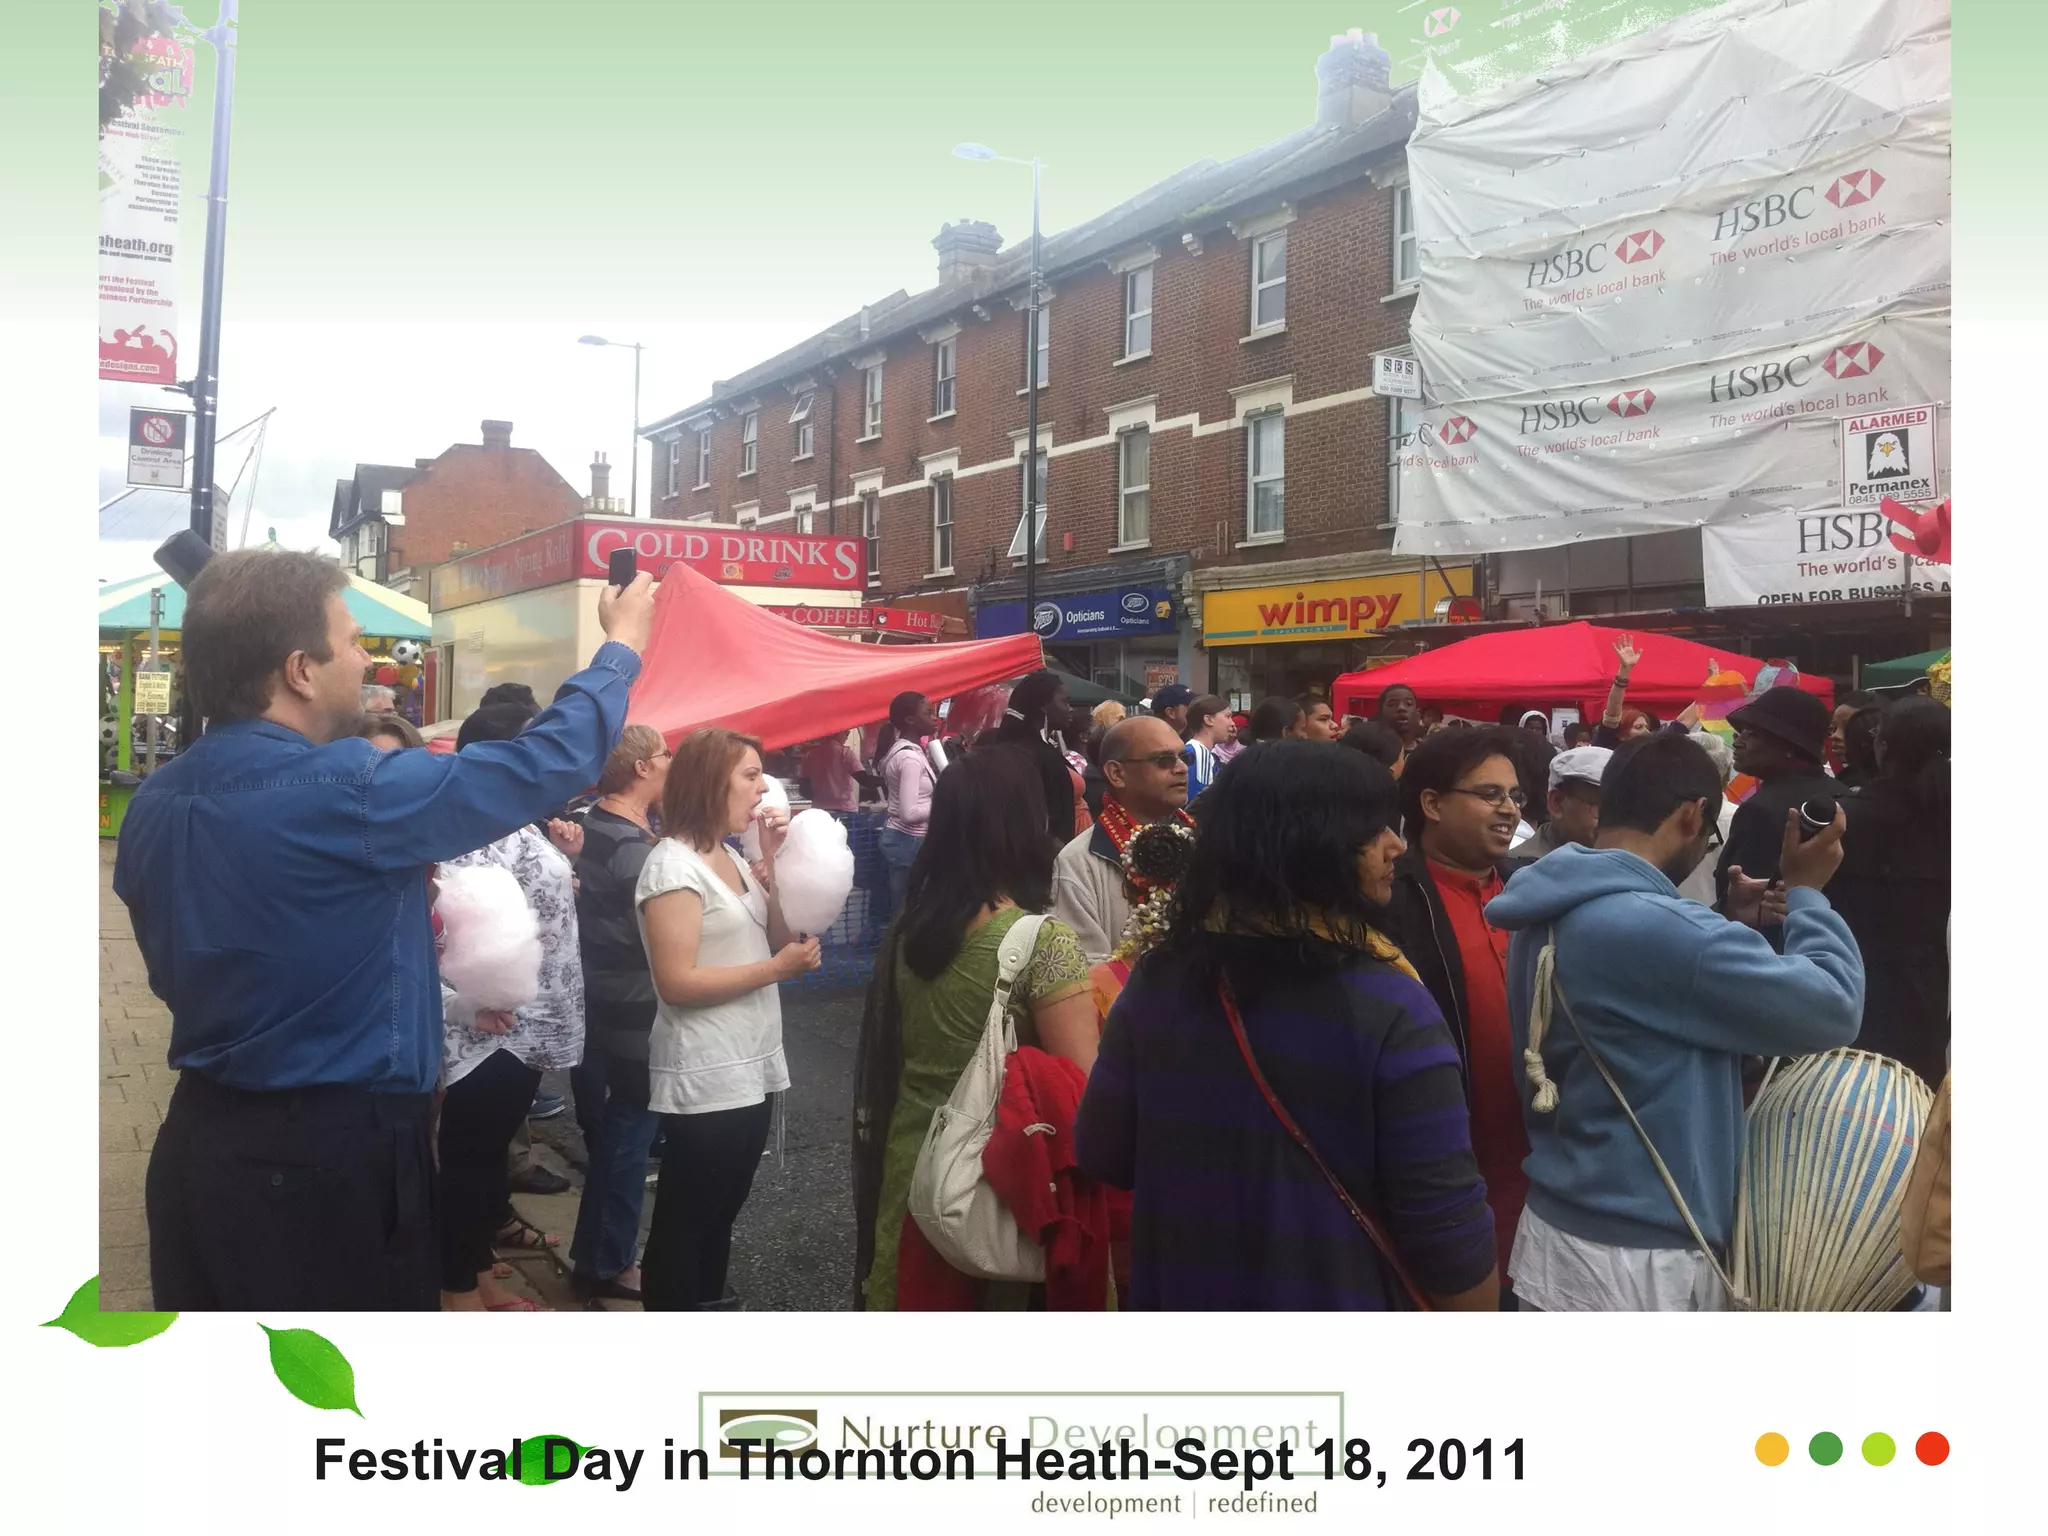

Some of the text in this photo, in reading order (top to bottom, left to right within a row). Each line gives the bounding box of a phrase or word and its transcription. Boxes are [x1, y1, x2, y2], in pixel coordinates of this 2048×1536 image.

[1712, 184, 1816, 242] HSBC
[1709, 211, 1887, 267] The world's local bank
[1526, 242, 1608, 289] HSBC
[1523, 267, 1666, 311] The world's local bank
[129, 296, 173, 307] Partnership
[1710, 354, 1812, 403] HSBC
[1519, 396, 1603, 435] HSBC
[1709, 386, 1889, 429] The world's local bank
[1848, 410, 1928, 433] ALARMED
[1516, 425, 1661, 457] The world's local bank
[131, 455, 161, 463] Control
[163, 457, 182, 466] Area
[1451, 451, 1480, 467] bank
[1848, 494, 1876, 505] 0845
[1903, 488, 1932, 499] 5555
[1849, 478, 1931, 496] Permanex
[588, 528, 858, 581] COLD DRINKS
[1798, 562, 1828, 578] The
[1833, 556, 1897, 577] world's
[1758, 592, 1803, 605] OPEN
[1808, 589, 1843, 603] FOR
[791, 607, 870, 625] COFFEE
[906, 612, 928, 628] Hot
[1066, 609, 1105, 624] Opticians
[1120, 616, 1150, 625] Opticians
[1258, 592, 1402, 630] wimpy
